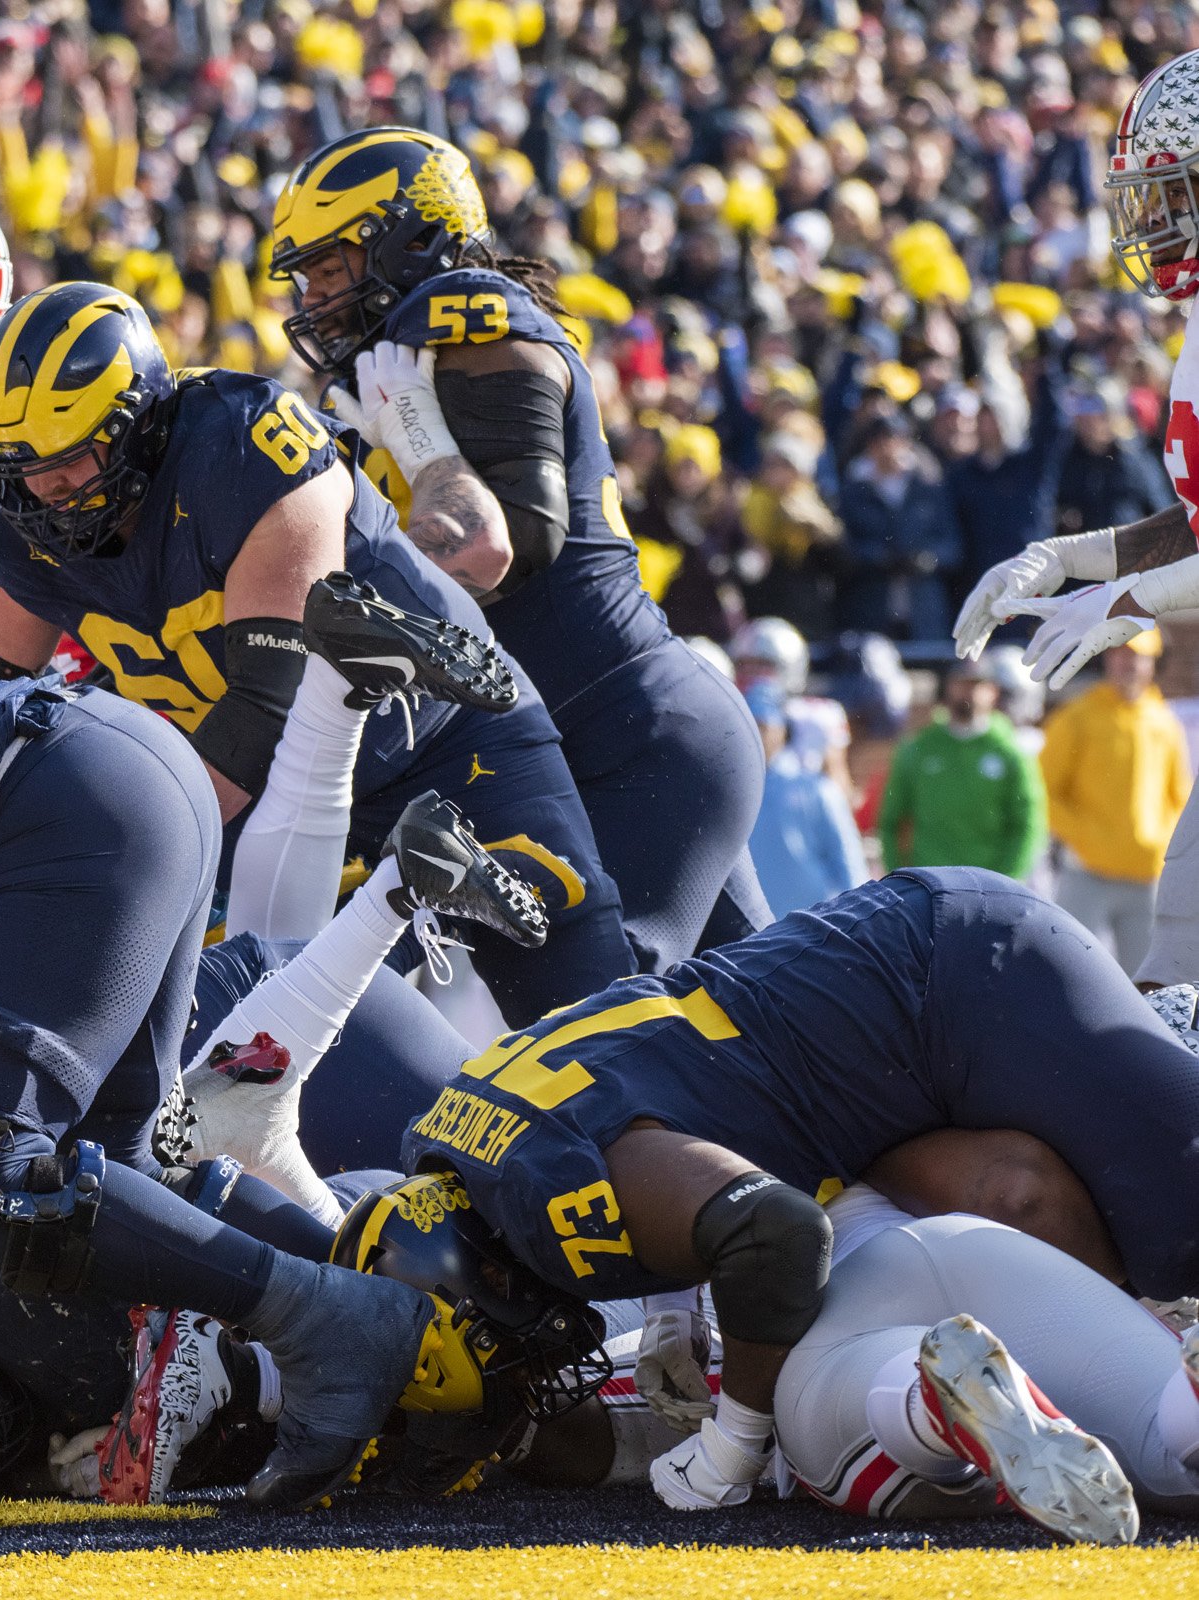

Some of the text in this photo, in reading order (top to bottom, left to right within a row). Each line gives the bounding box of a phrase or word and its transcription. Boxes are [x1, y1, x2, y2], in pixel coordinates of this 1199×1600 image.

[425, 293, 510, 346] 53
[251, 391, 330, 475] 60
[412, 1086, 531, 1166] HENDERSON
[546, 1179, 633, 1279] 73
